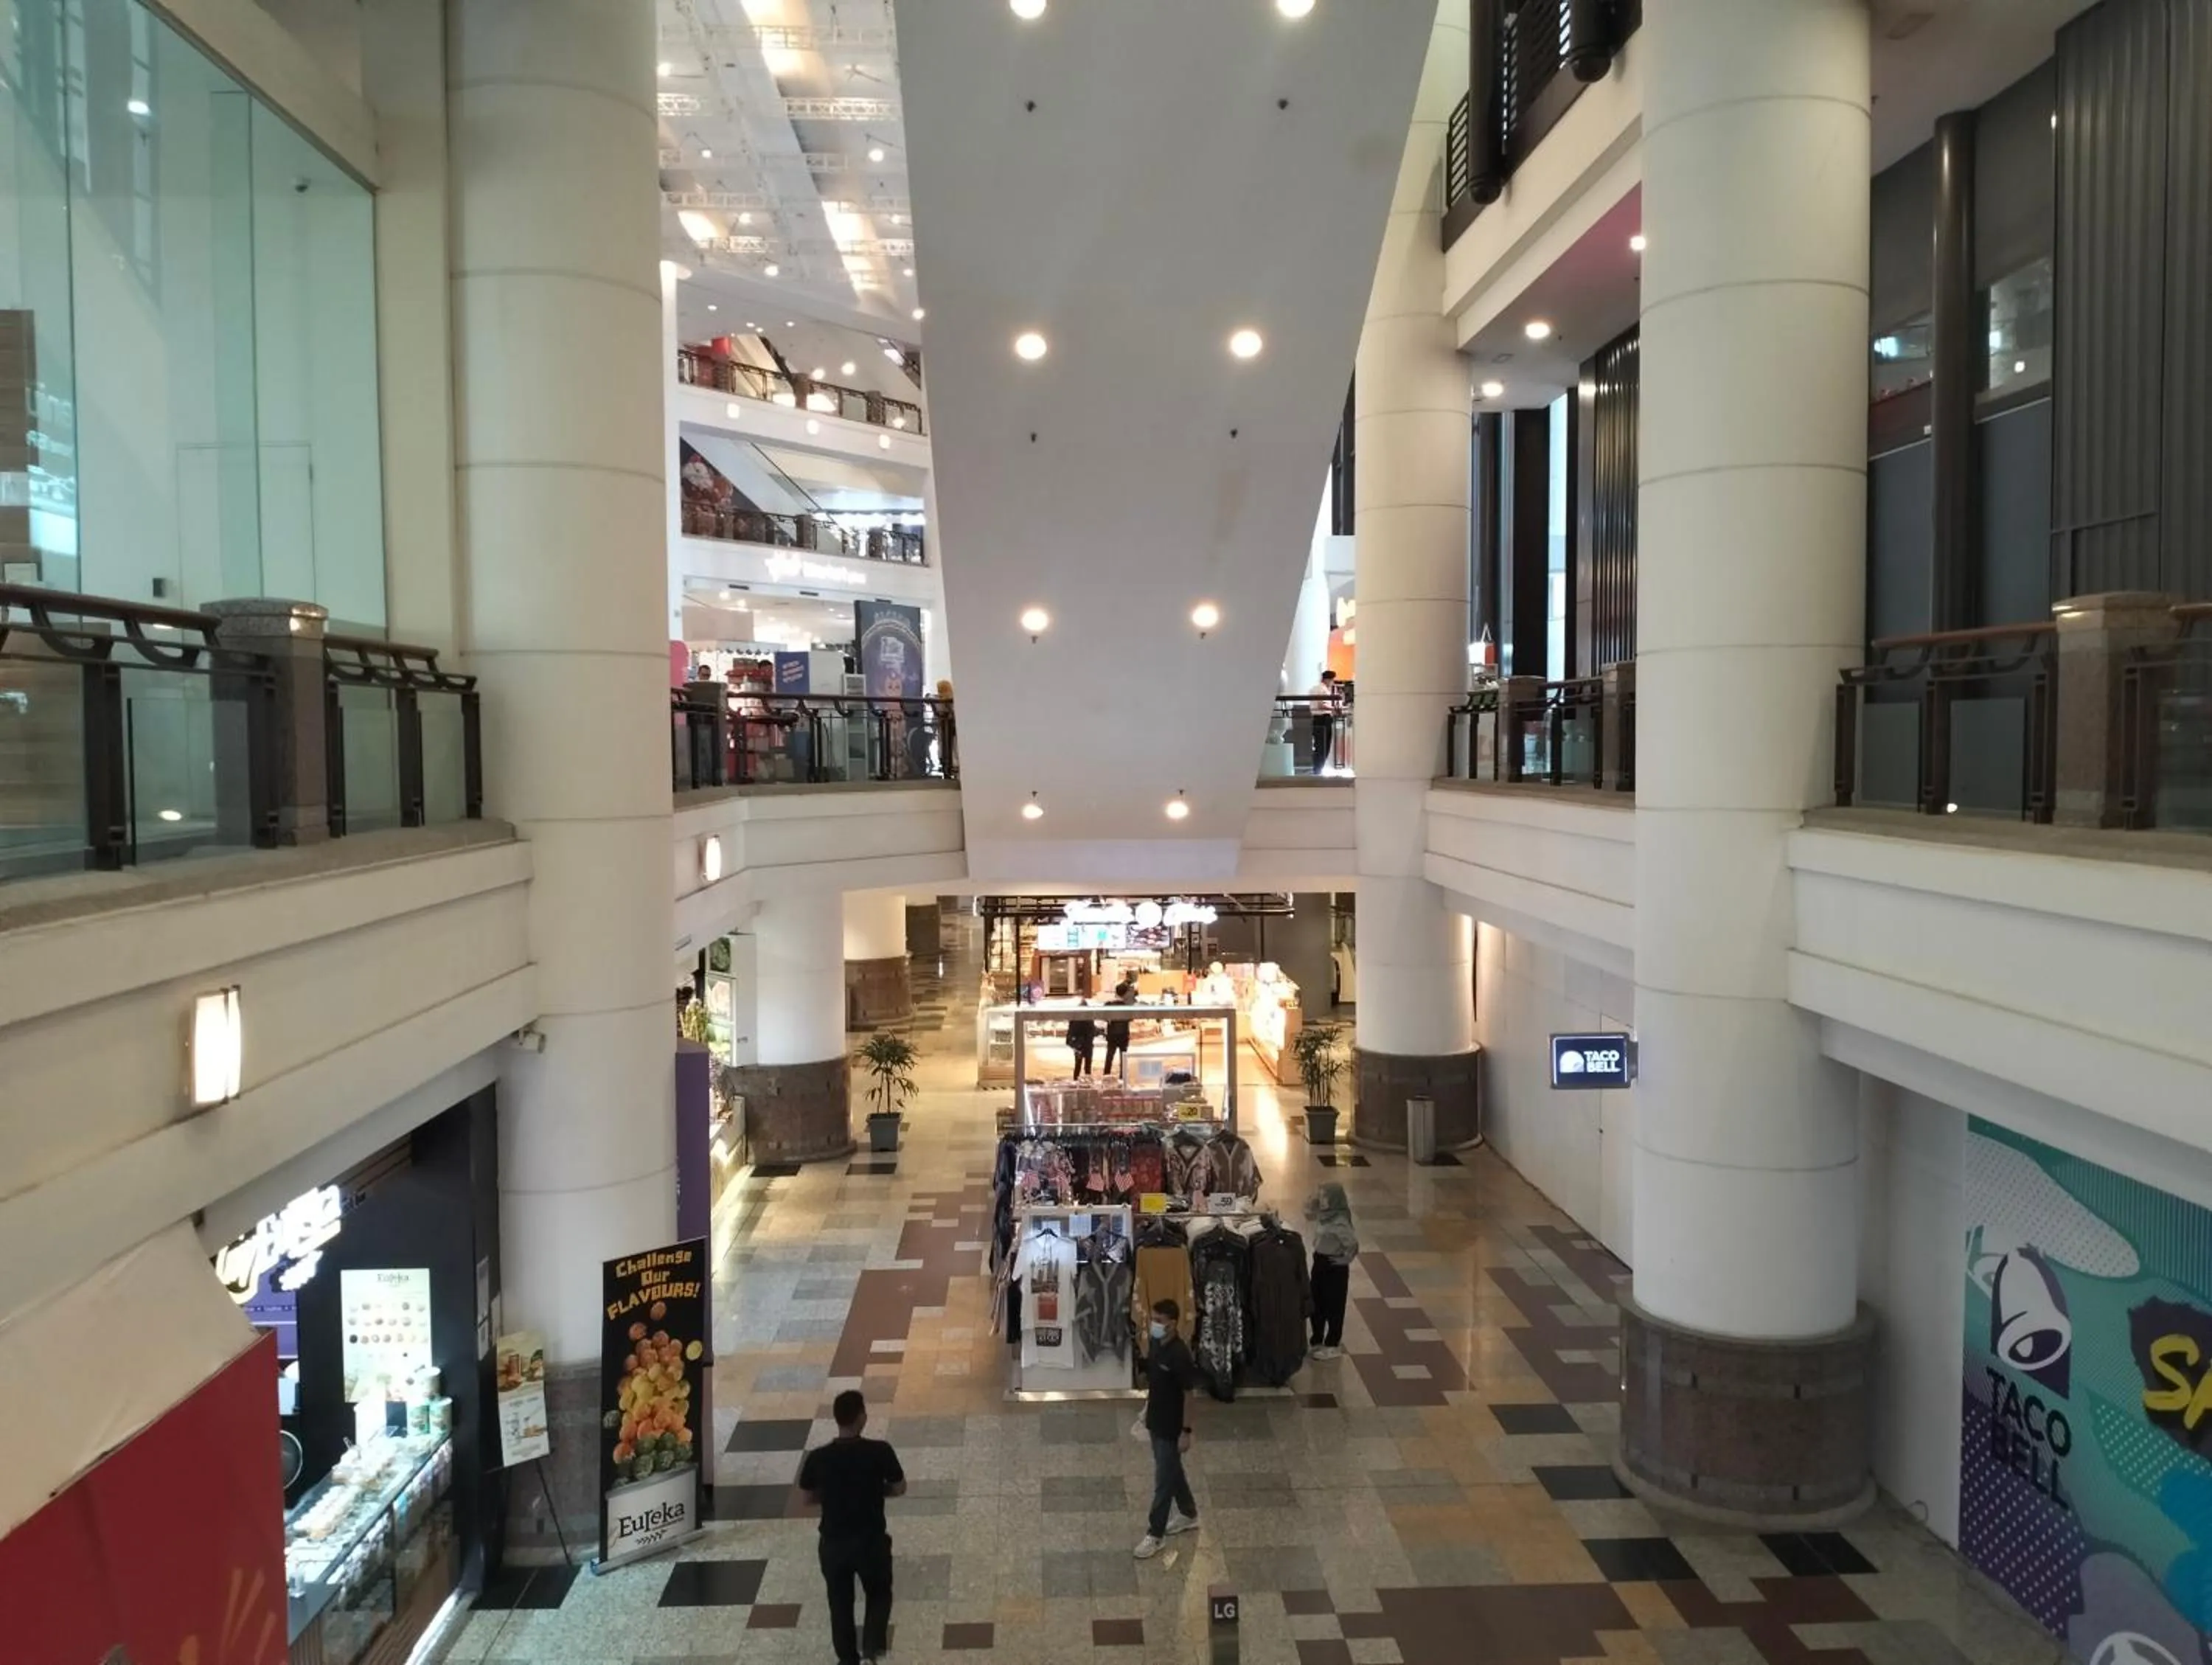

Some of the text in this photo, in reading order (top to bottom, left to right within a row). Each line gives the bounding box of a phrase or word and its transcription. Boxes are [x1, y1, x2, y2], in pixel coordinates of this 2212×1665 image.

[1583, 1050, 1620, 1062] TACO
[1586, 1061, 1621, 1073] BELL
[615, 1250, 692, 1278] Challenge
[640, 1269, 671, 1287] Our
[607, 1282, 701, 1321] FLAVOURS!
[1986, 1366, 2072, 1457] TACO
[1990, 1418, 2069, 1510] BELL
[618, 1501, 685, 1539] Eureka
[1214, 1602, 1236, 1619] LG
